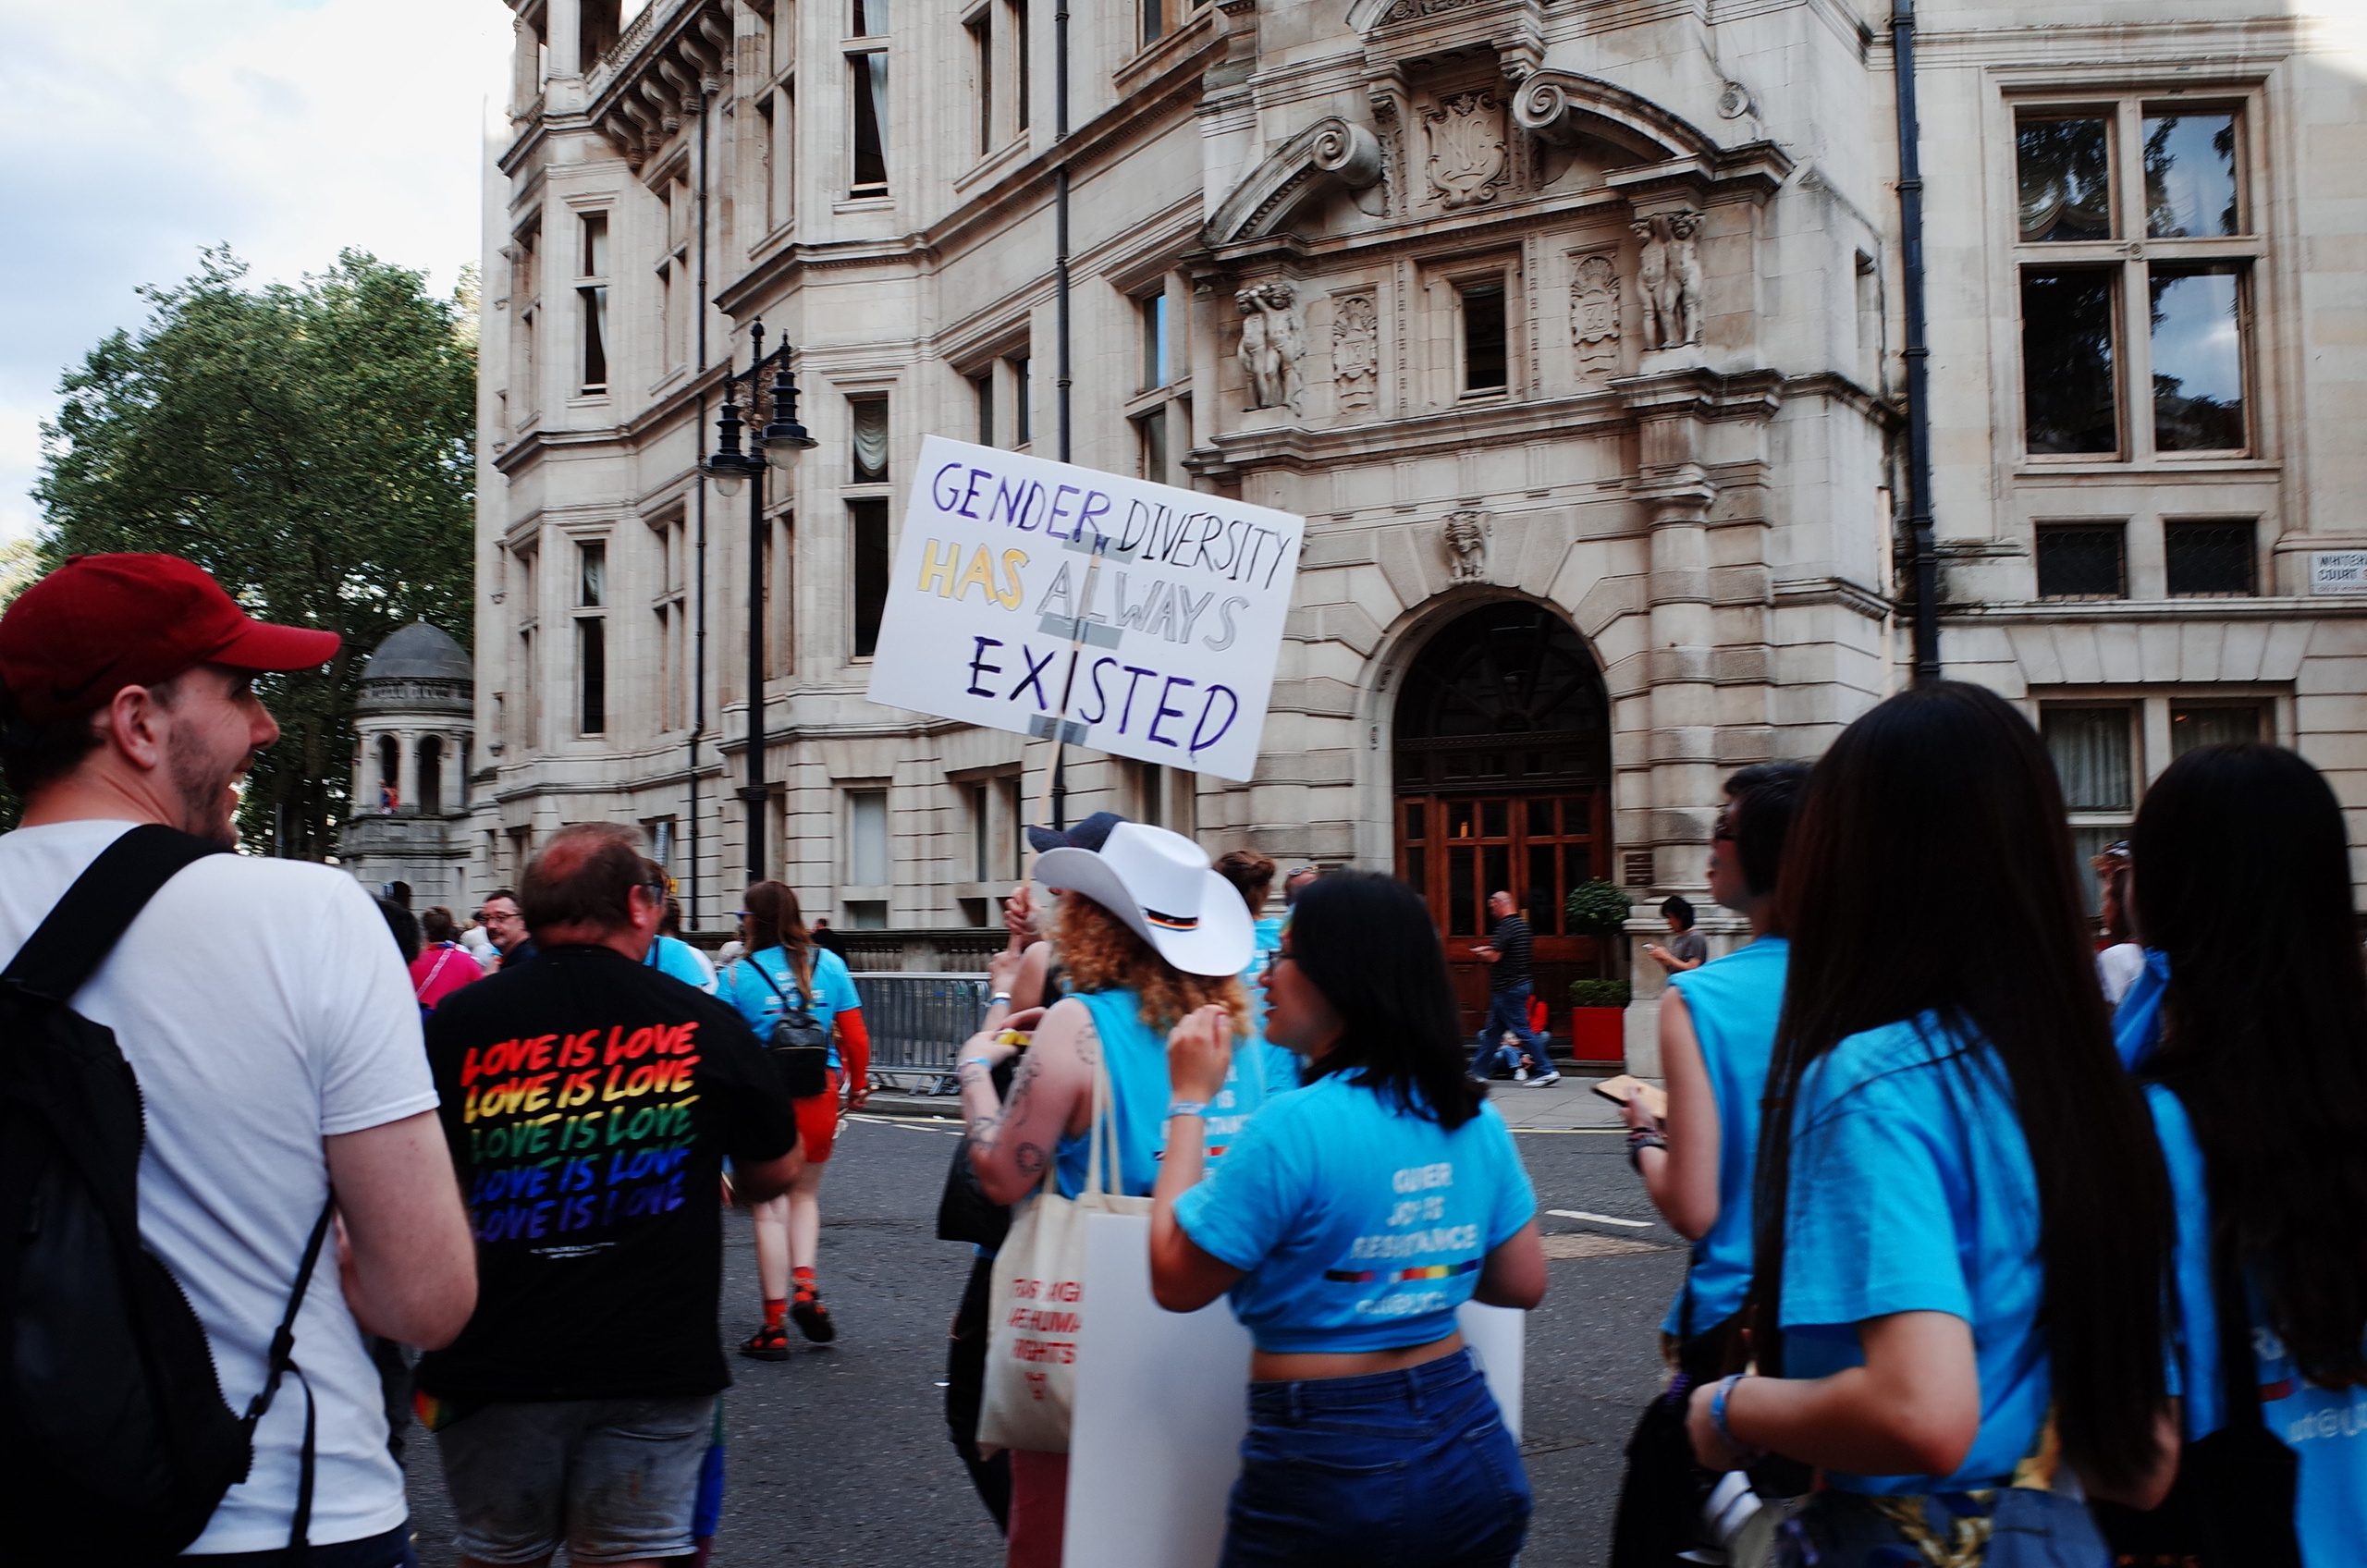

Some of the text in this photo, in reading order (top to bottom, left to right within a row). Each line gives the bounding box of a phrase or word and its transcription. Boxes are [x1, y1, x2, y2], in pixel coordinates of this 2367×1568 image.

[933, 462, 1293, 590] GENDER DIVERSITY
[917, 538, 1250, 652] HAS ALWAYS
[966, 636, 1238, 754] EXISTED
[460, 1021, 701, 1086] LOVE IS LOVE
[463, 1055, 702, 1123] LOVE IS LOVE
[470, 1095, 701, 1165] LOVE IS LOVE
[470, 1156, 561, 1207] LOVE
[558, 1153, 601, 1193] IS
[471, 1170, 687, 1243] LOVE IS LOVE
